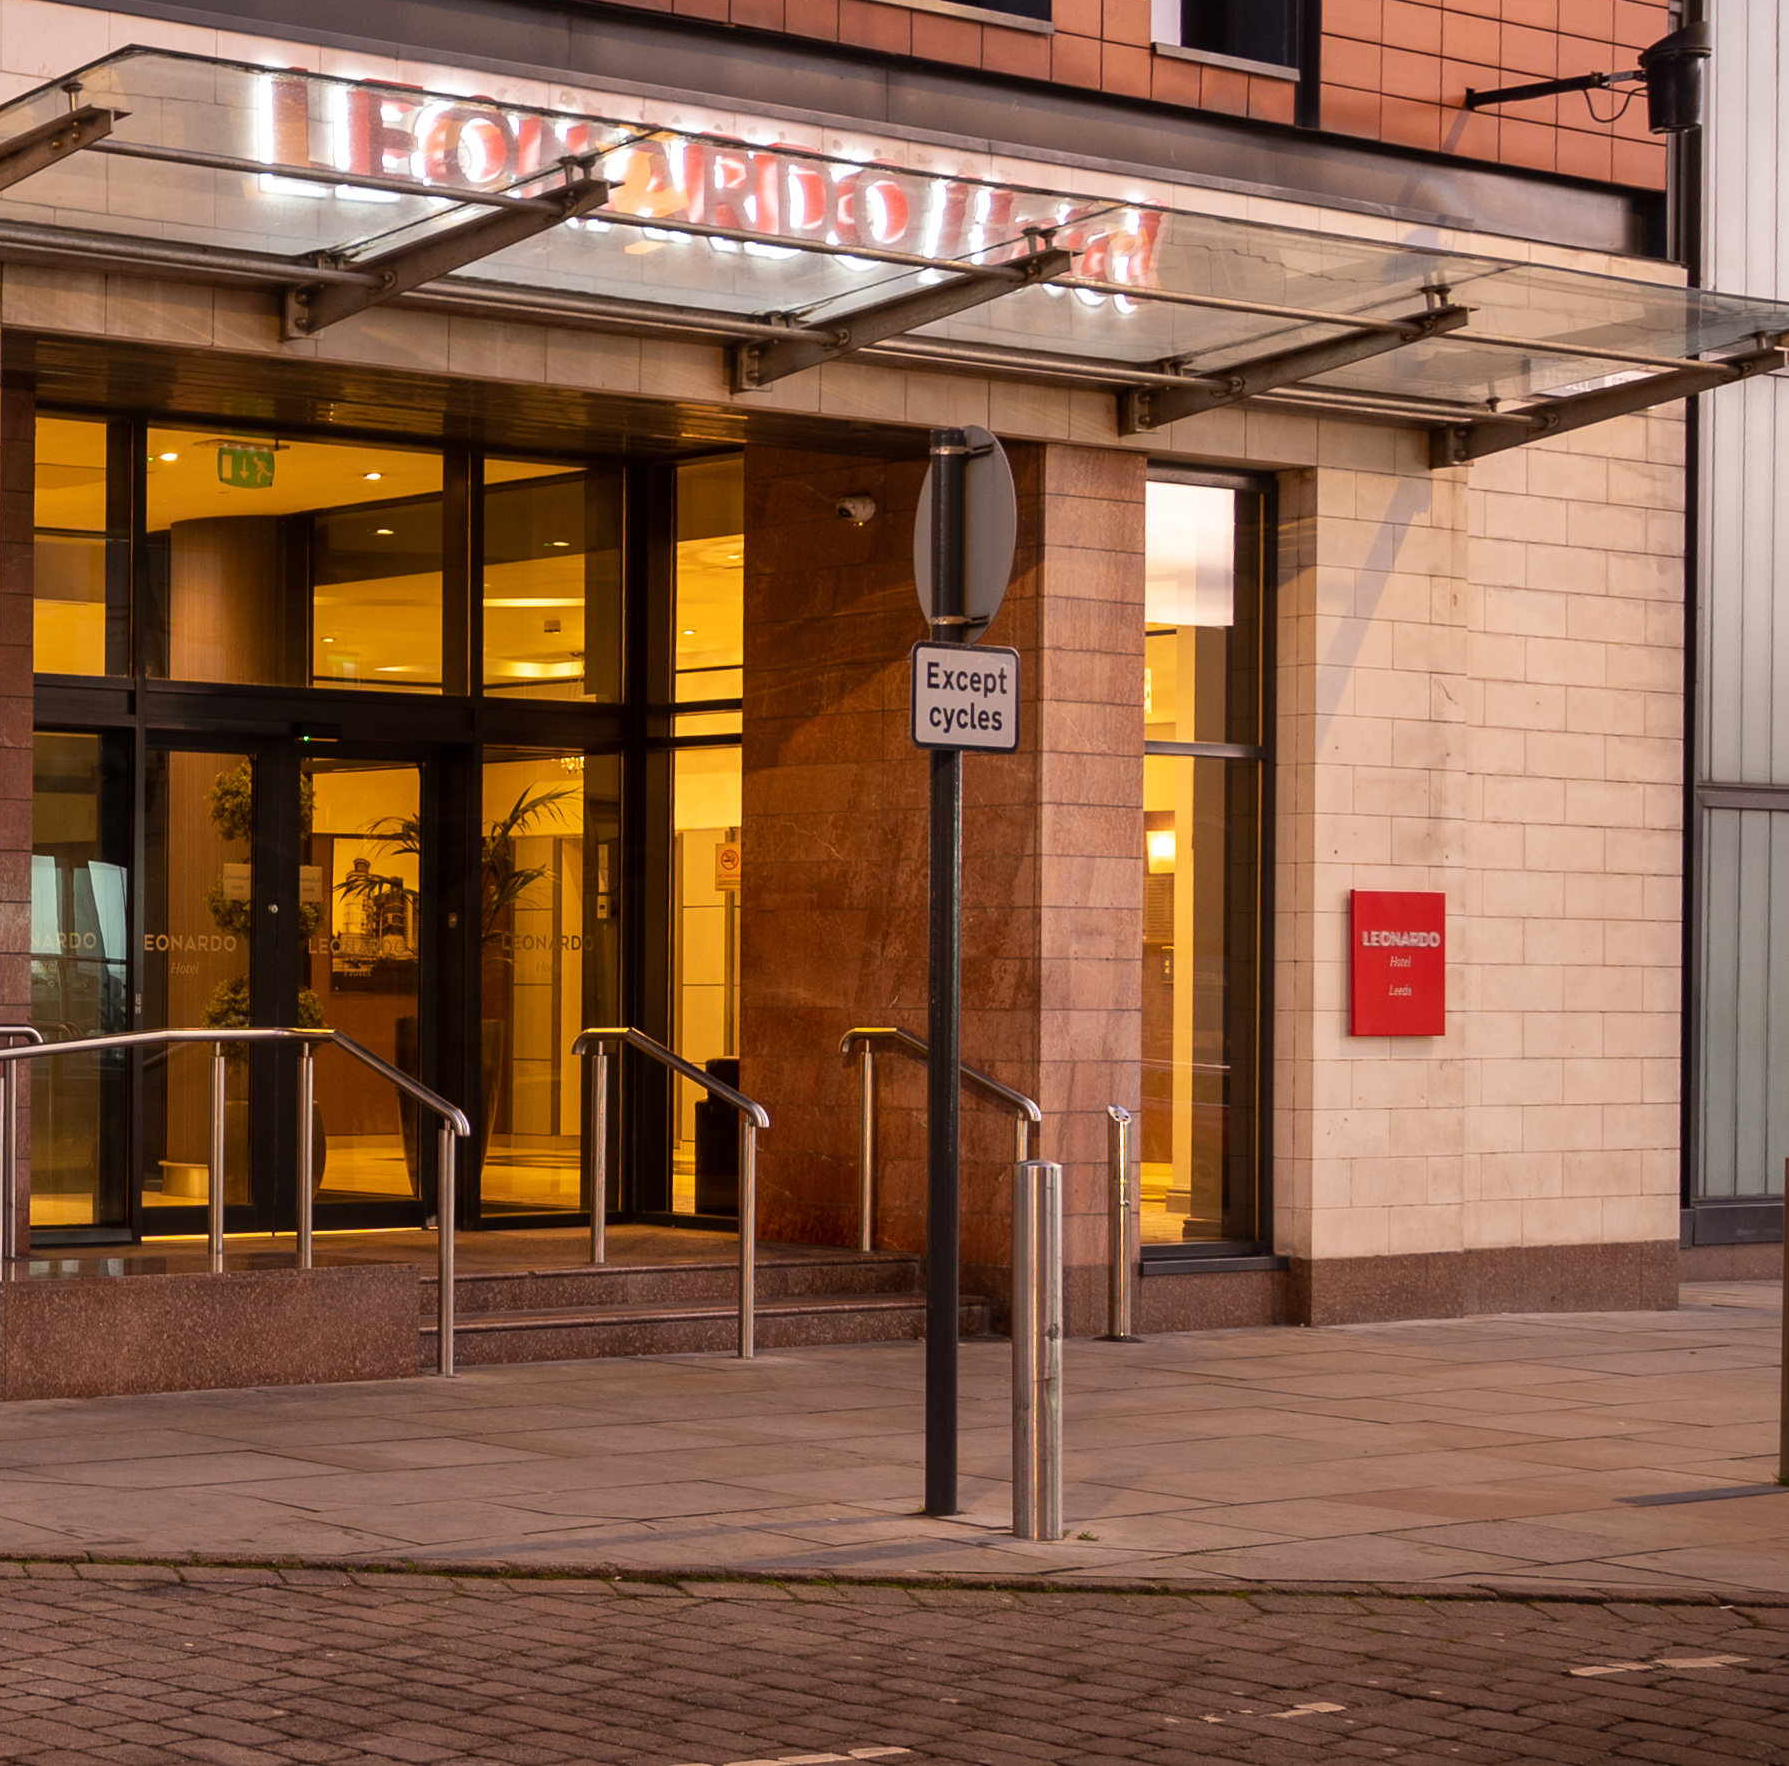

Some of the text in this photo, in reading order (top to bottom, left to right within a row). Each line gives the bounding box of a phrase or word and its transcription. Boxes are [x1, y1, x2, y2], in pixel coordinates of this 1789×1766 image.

[927, 662, 1007, 698] Except
[929, 702, 1003, 733] cycles
[31, 932, 97, 949] NARDO
[144, 934, 237, 952] EONARDO
[1362, 931, 1441, 948] LEONARDO
[171, 962, 200, 975] Hotel
[1389, 956, 1412, 967] Hotel
[1388, 984, 1413, 996] Leeds
